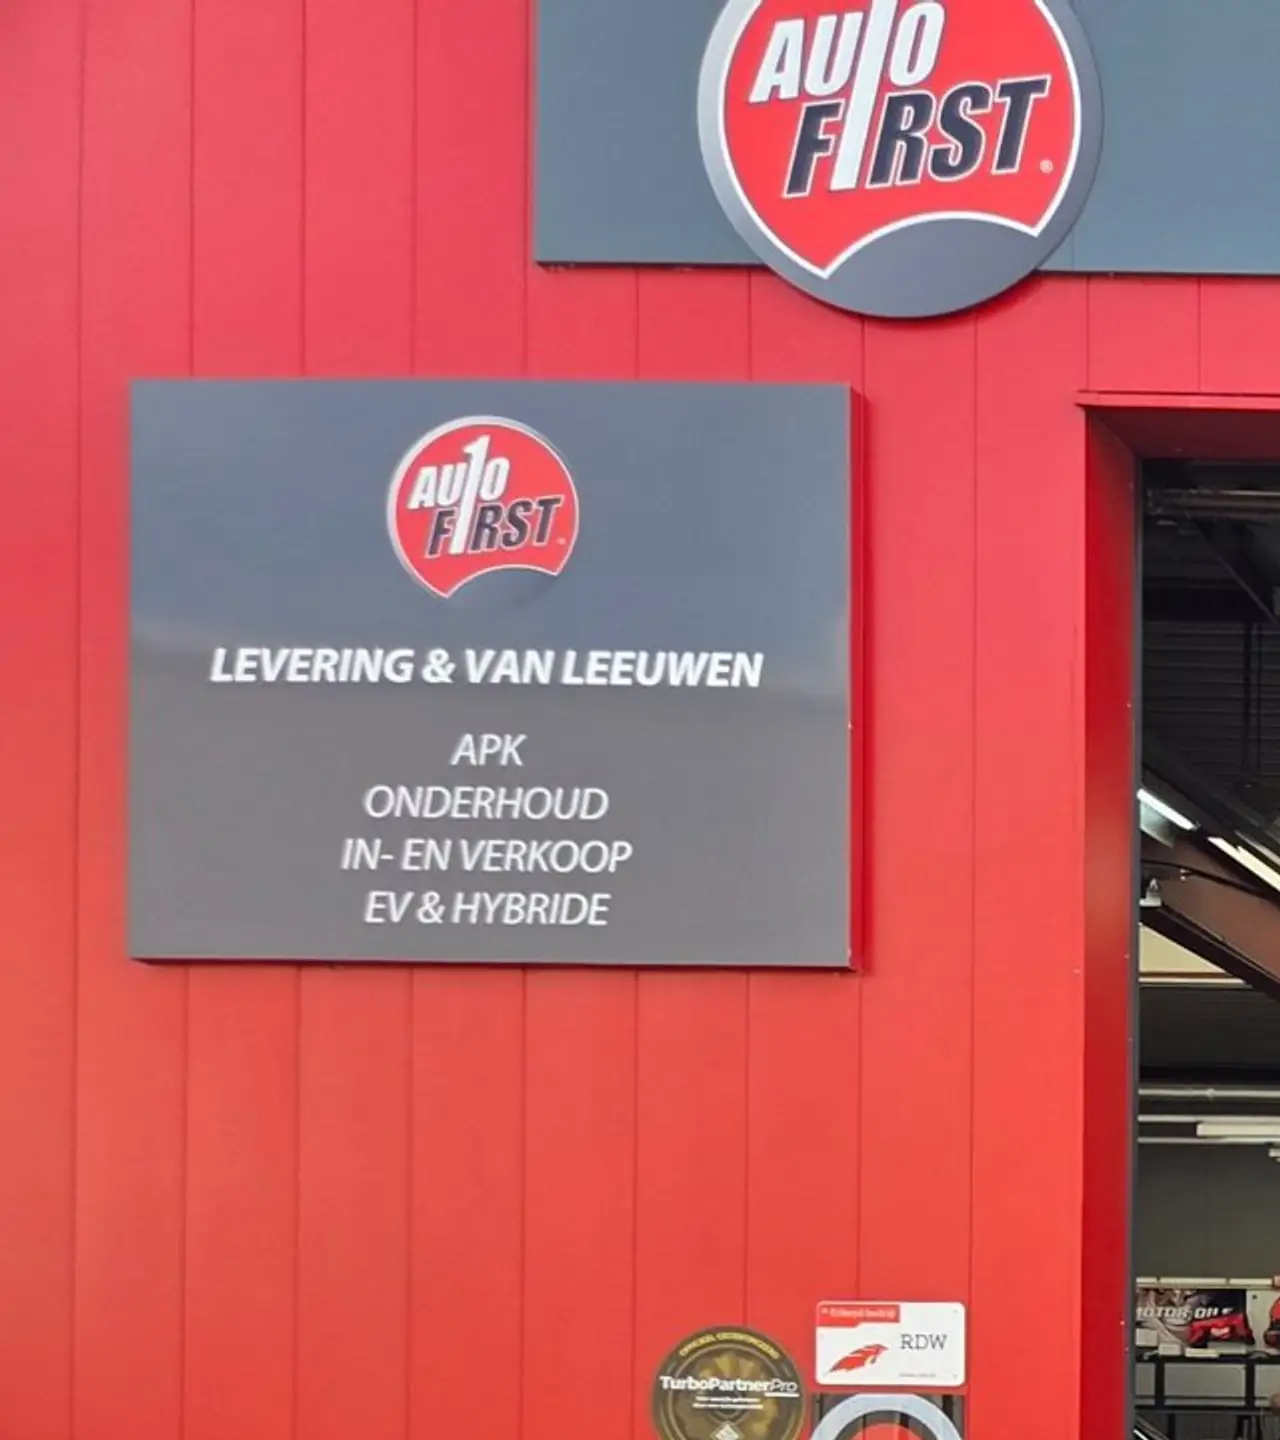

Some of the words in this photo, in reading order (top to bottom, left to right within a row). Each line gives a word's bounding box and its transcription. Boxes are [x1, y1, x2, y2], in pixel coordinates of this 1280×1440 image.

[782, 74, 1051, 198] FIRST
[424, 494, 566, 559] FIRST
[209, 647, 415, 685] LEVERING
[422, 648, 456, 685] &
[464, 648, 556, 687] VAN
[560, 649, 766, 689] LEEUWEN
[450, 733, 527, 767] APK
[362, 784, 610, 821] ONDERHOUD
[340, 837, 396, 870] IN-
[400, 837, 453, 872] EN
[459, 838, 634, 874] VERKOOP
[363, 890, 416, 924] EV
[416, 890, 447, 925] &
[450, 891, 613, 926] HYBRIDE
[899, 1333, 948, 1351] RDW
